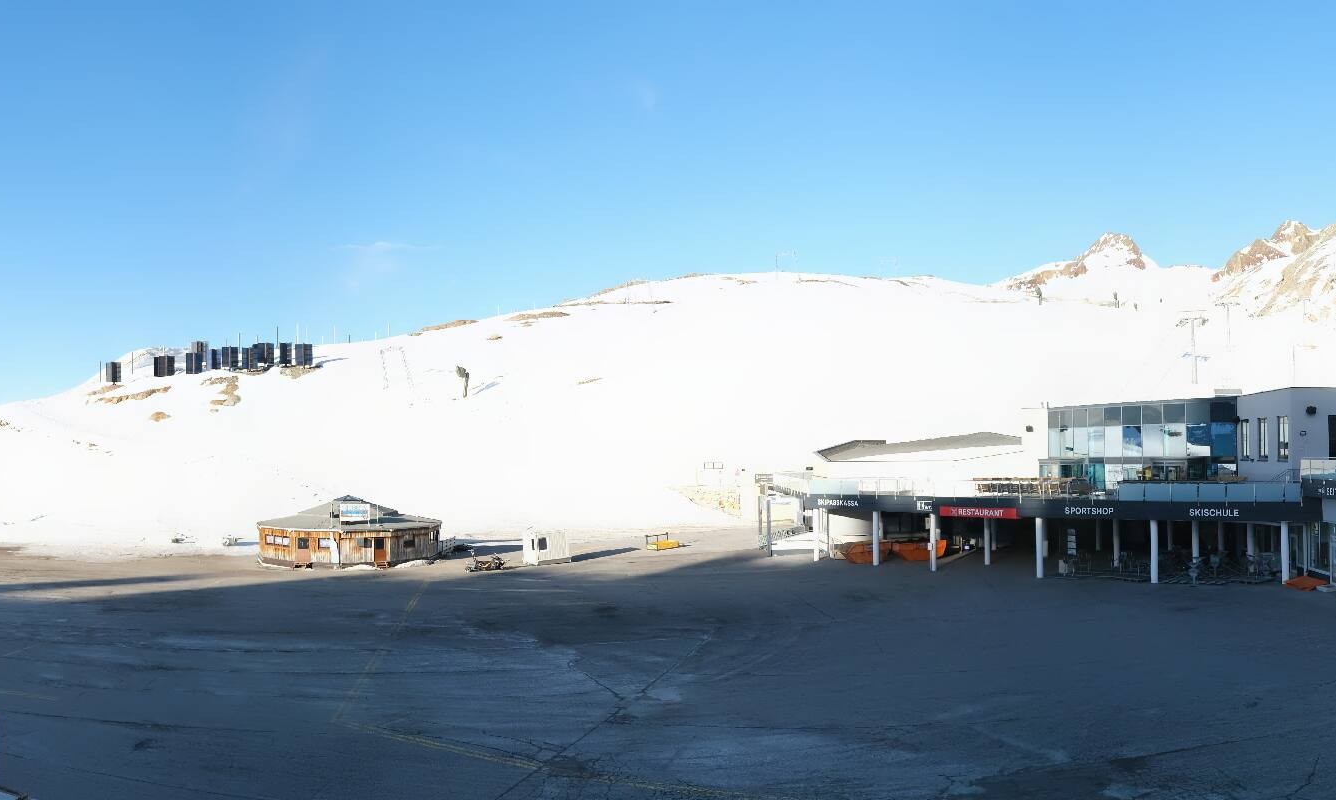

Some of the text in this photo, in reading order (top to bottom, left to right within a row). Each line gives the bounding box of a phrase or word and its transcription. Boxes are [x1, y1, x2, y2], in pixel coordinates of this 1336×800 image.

[817, 498, 859, 507] SKIPASSKASSA
[958, 508, 1004, 517] RESTAURANT
[1064, 507, 1114, 515] SPORTSHOP
[1189, 508, 1240, 517] SKISCHULE
